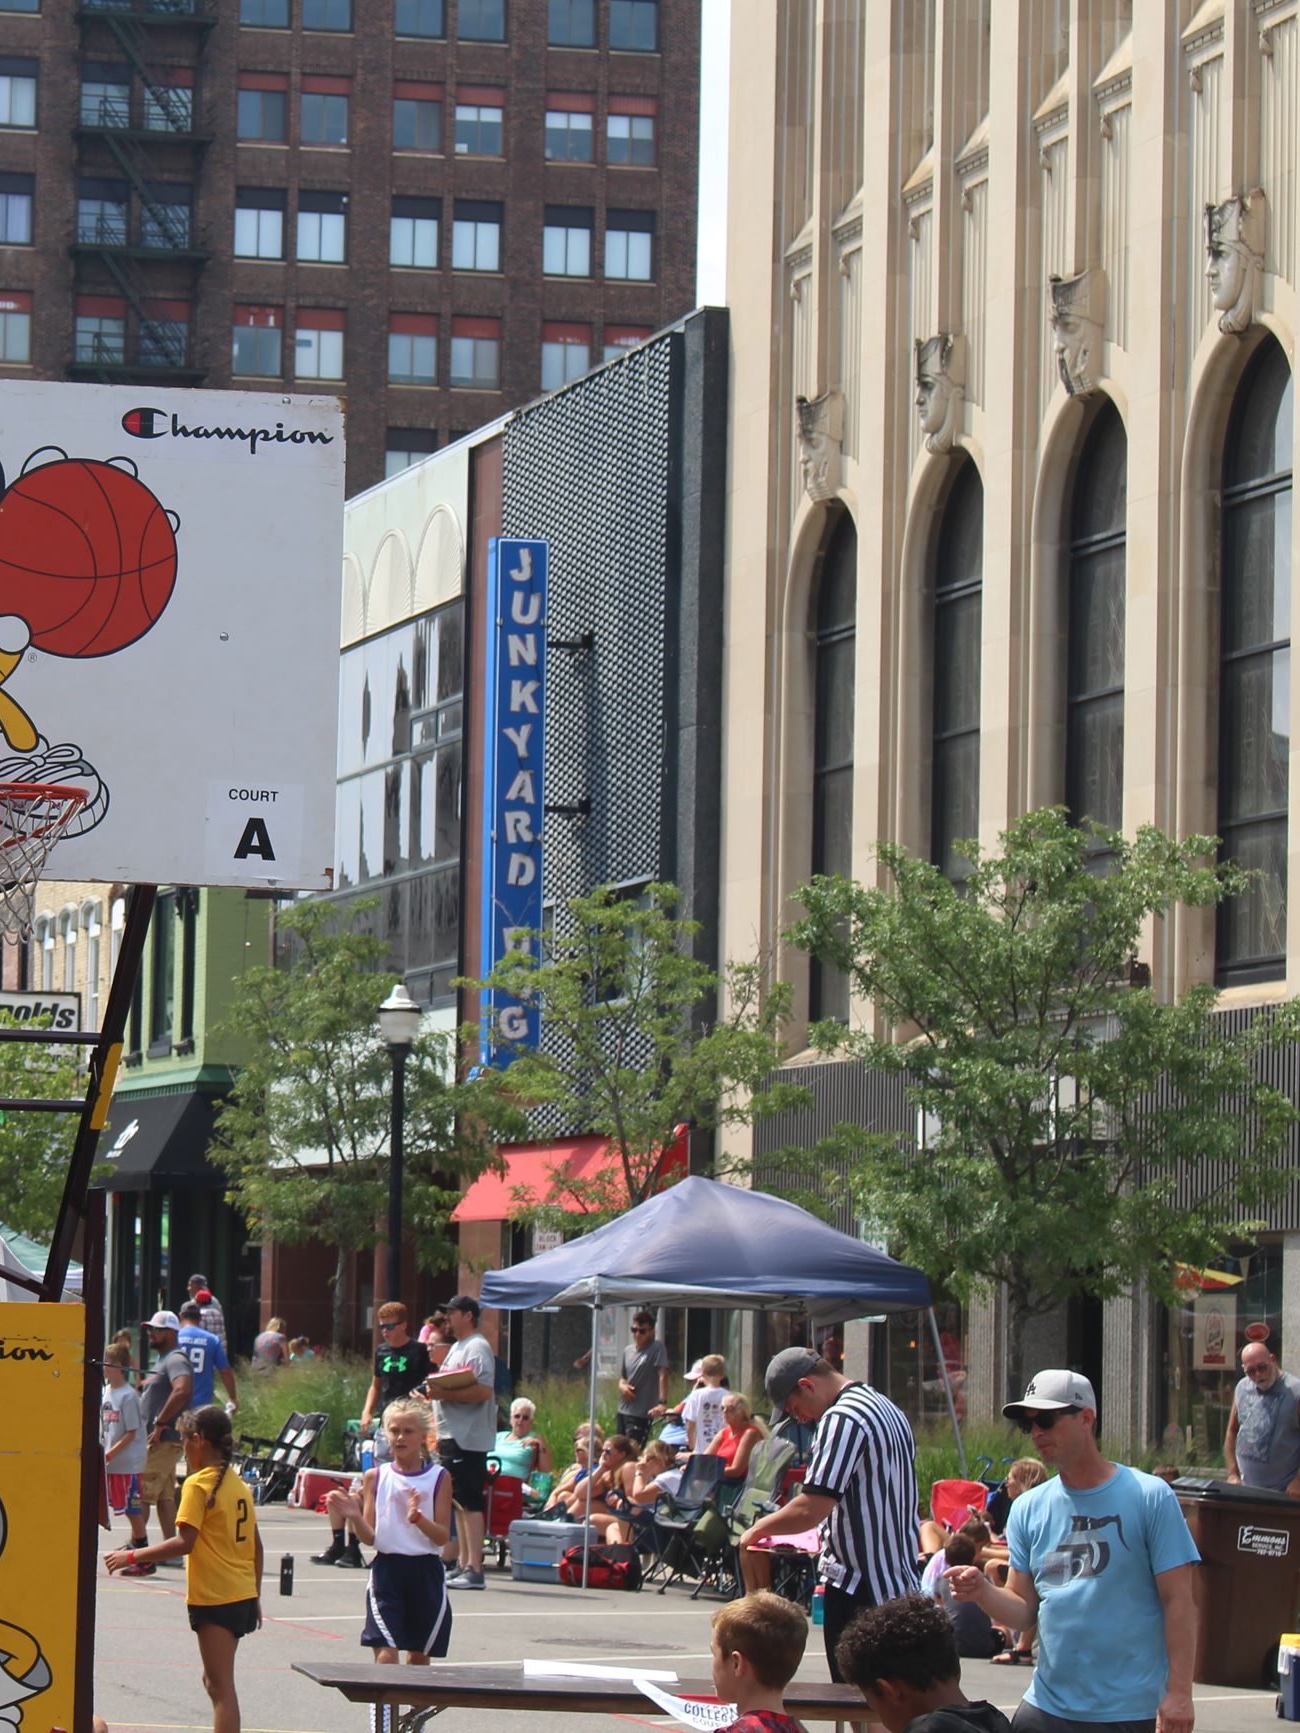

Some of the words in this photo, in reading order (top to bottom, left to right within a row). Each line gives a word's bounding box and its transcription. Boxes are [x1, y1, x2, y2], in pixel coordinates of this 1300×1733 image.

[121, 407, 334, 454] Champion
[502, 548, 541, 886] JUNKYARD
[228, 788, 279, 802] COURT
[233, 817, 276, 861] A
[235, 1498, 248, 1543] 2
[1241, 1525, 1286, 1545] Emmons
[684, 1702, 734, 1723] COLLEG
